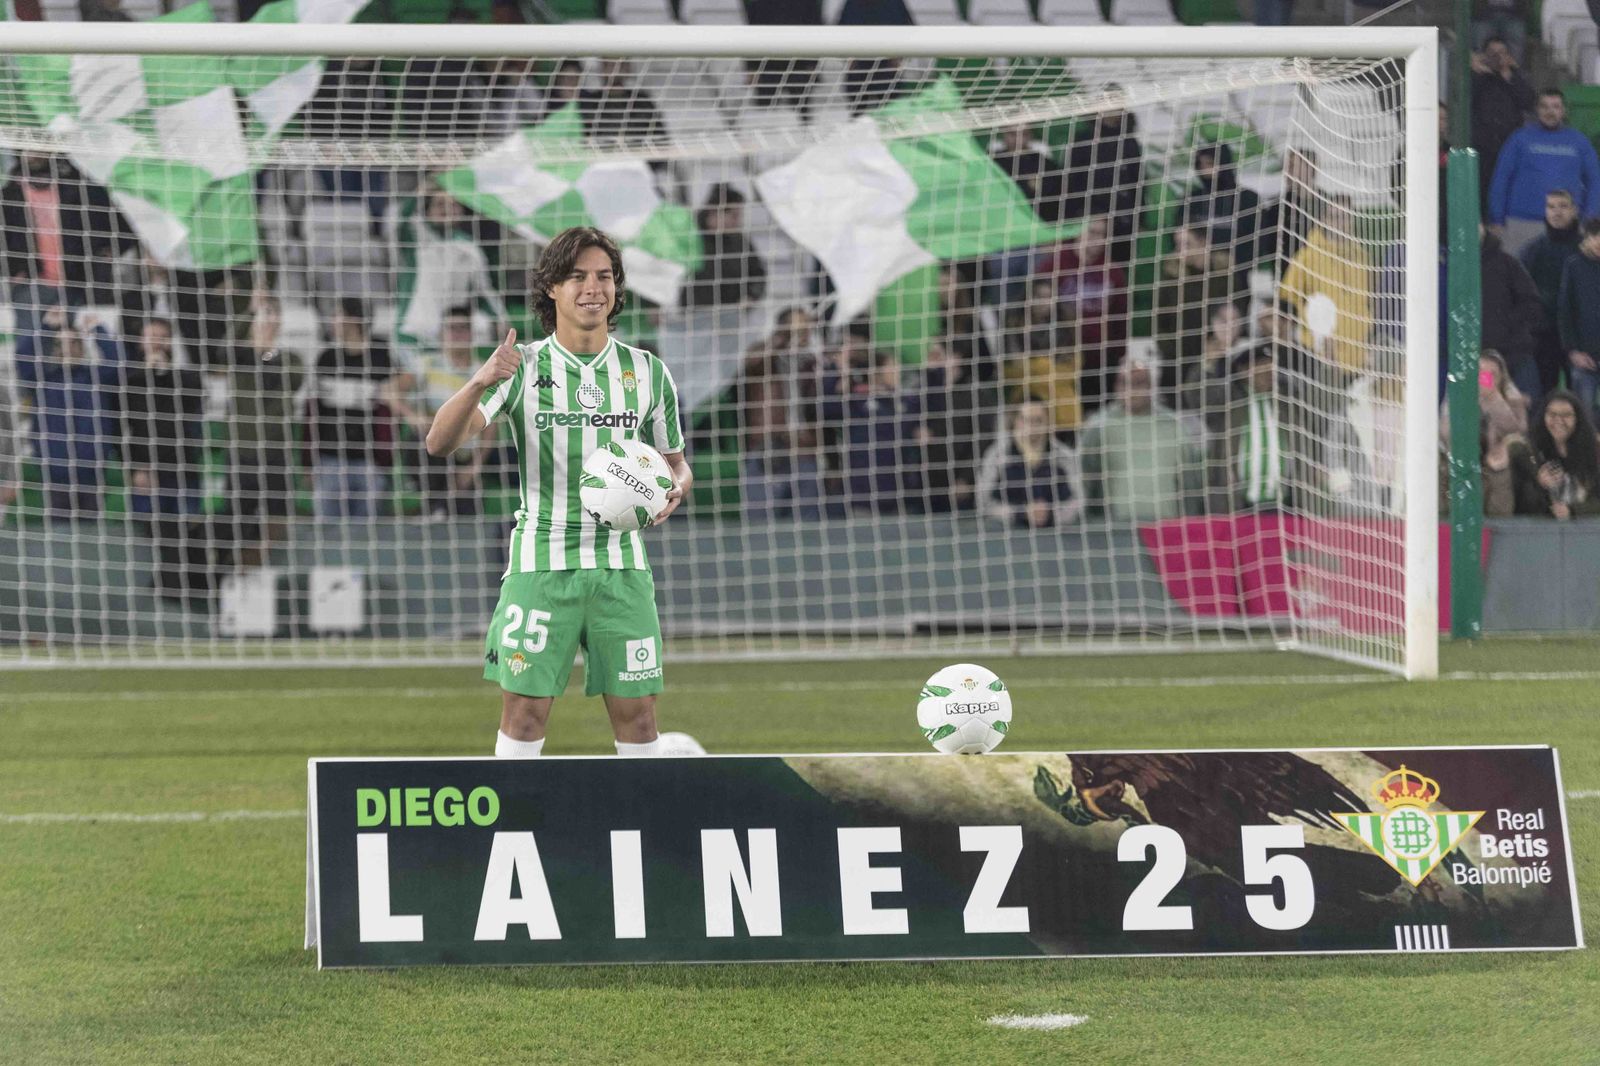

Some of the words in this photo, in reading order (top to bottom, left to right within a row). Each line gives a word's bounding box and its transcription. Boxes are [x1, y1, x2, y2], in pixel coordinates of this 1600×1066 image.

[607, 462, 655, 500] Kappa
[501, 604, 552, 654] 25
[945, 702, 1000, 715] Kappa
[356, 786, 500, 827] DIEGO
[1496, 808, 1545, 830] Real
[1480, 834, 1549, 858] Betis
[356, 825, 1031, 942] LAINEZ
[1117, 824, 1316, 932] 25
[1452, 861, 1552, 888] Balompié
